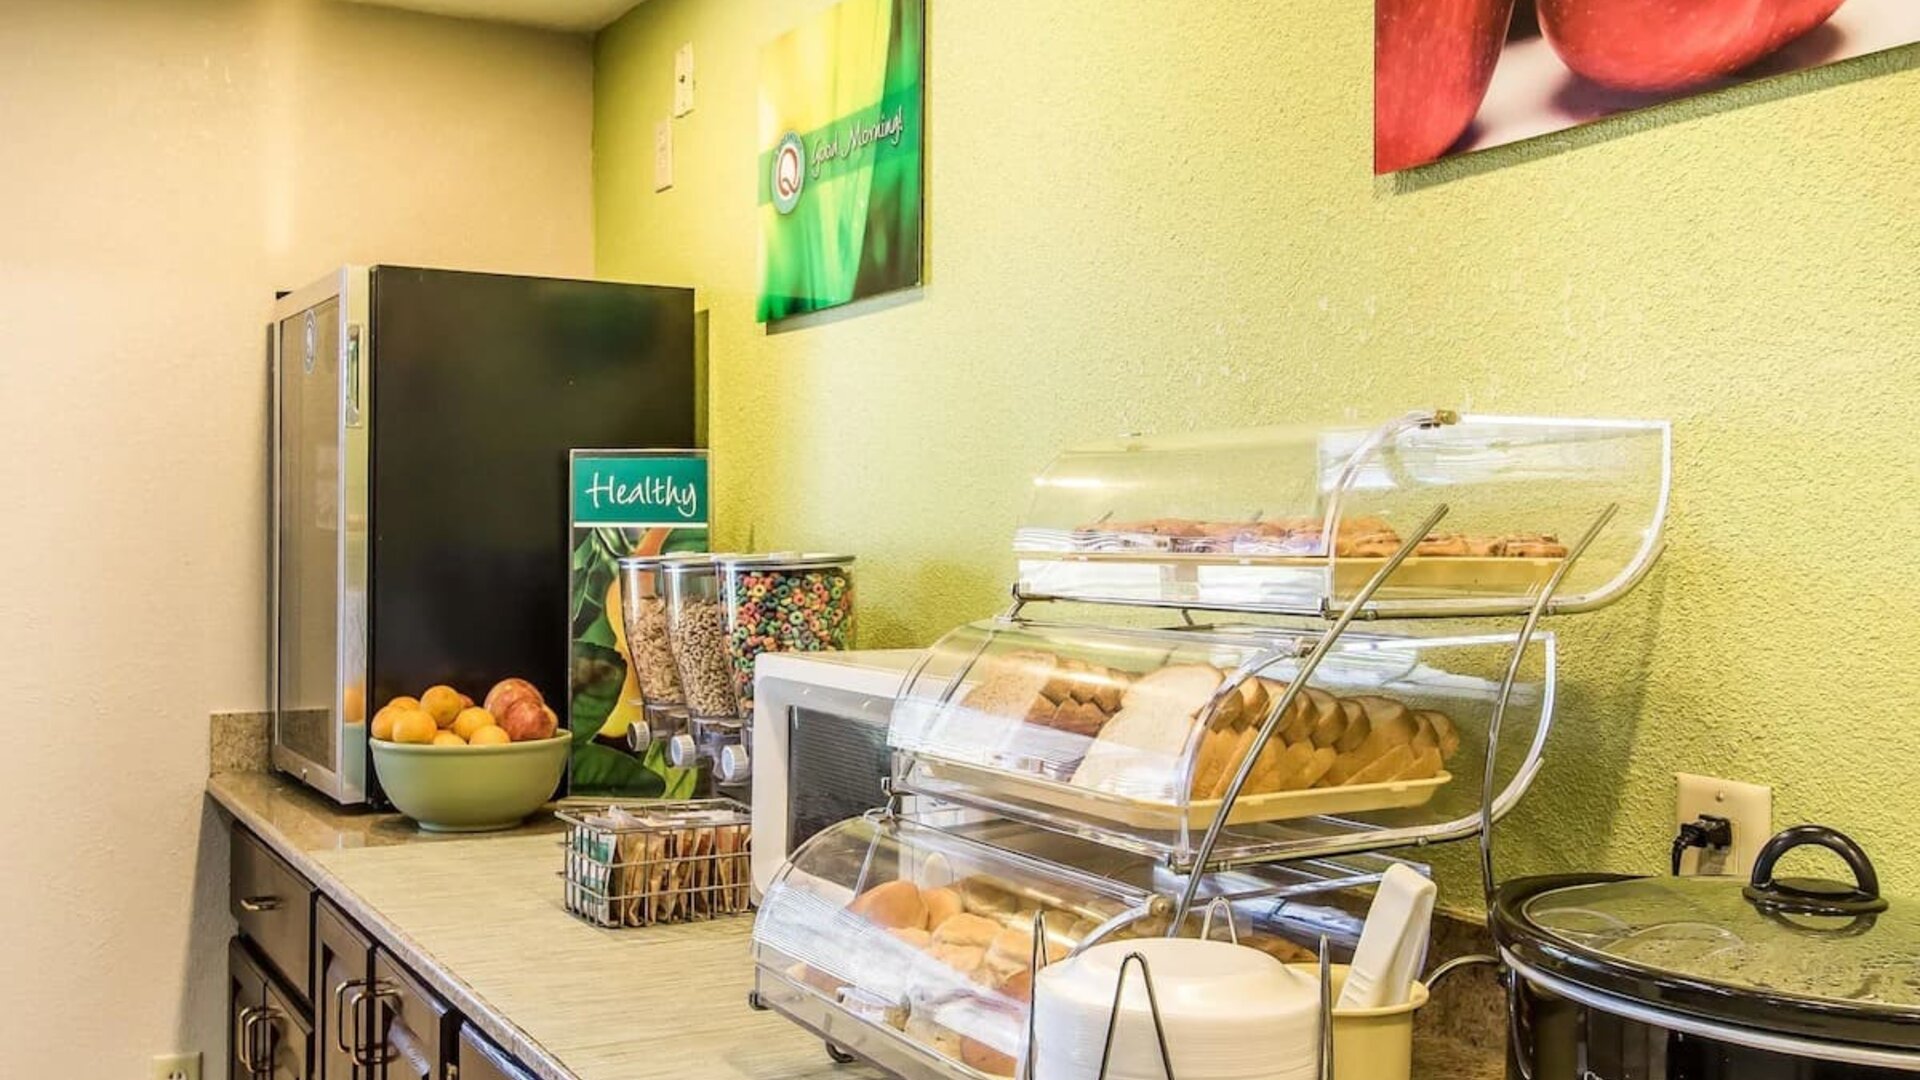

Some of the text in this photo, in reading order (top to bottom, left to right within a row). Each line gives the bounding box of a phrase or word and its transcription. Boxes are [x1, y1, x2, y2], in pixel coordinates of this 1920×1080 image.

[811, 131, 839, 180] Good
[842, 105, 904, 160] Morning!
[779, 147, 801, 197] Q
[584, 472, 697, 517] Healthy
